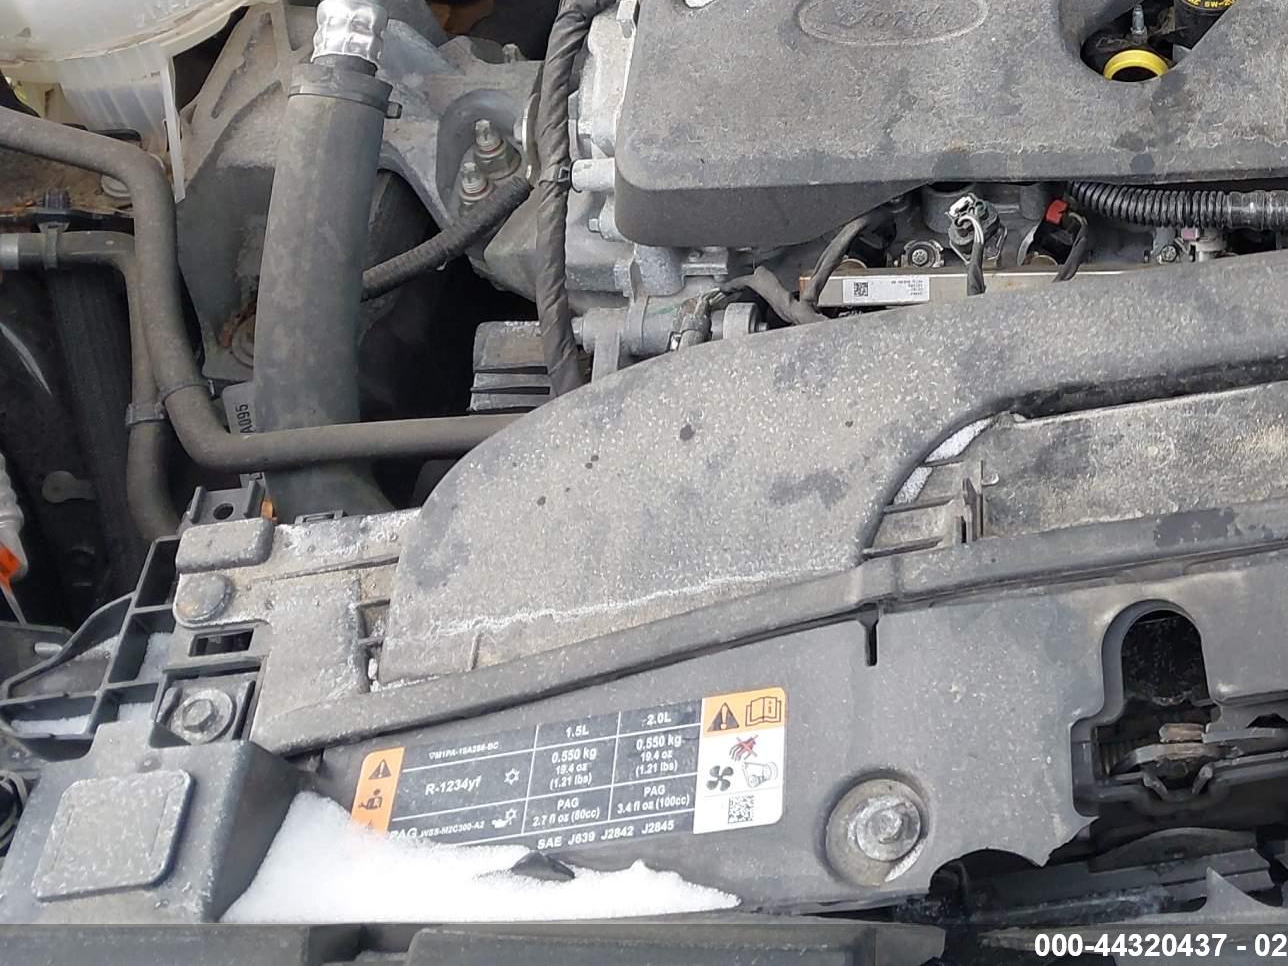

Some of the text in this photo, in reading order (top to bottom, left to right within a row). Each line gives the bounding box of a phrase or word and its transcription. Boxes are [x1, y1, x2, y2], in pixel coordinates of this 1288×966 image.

[646, 712, 672, 725] 2.0L
[565, 725, 590, 738] 1.5L
[668, 734, 682, 747] kg
[551, 747, 597, 763] 0.550 kg
[661, 749, 673, 758] oz
[576, 762, 588, 772] oz
[635, 760, 678, 778] (1.21 lbs)
[424, 775, 482, 796] R-1234yf
[549, 772, 593, 791] (1.21 lbs)
[643, 785, 666, 797] PAG
[557, 797, 580, 811] PAG
[617, 803, 632, 815] 3.4
[642, 801, 654, 811] oz
[532, 815, 547, 827] 2.7
[557, 814, 569, 824] oz
[389, 826, 418, 840] PAG
[537, 819, 675, 850] SAE J639 J2842 J2845
